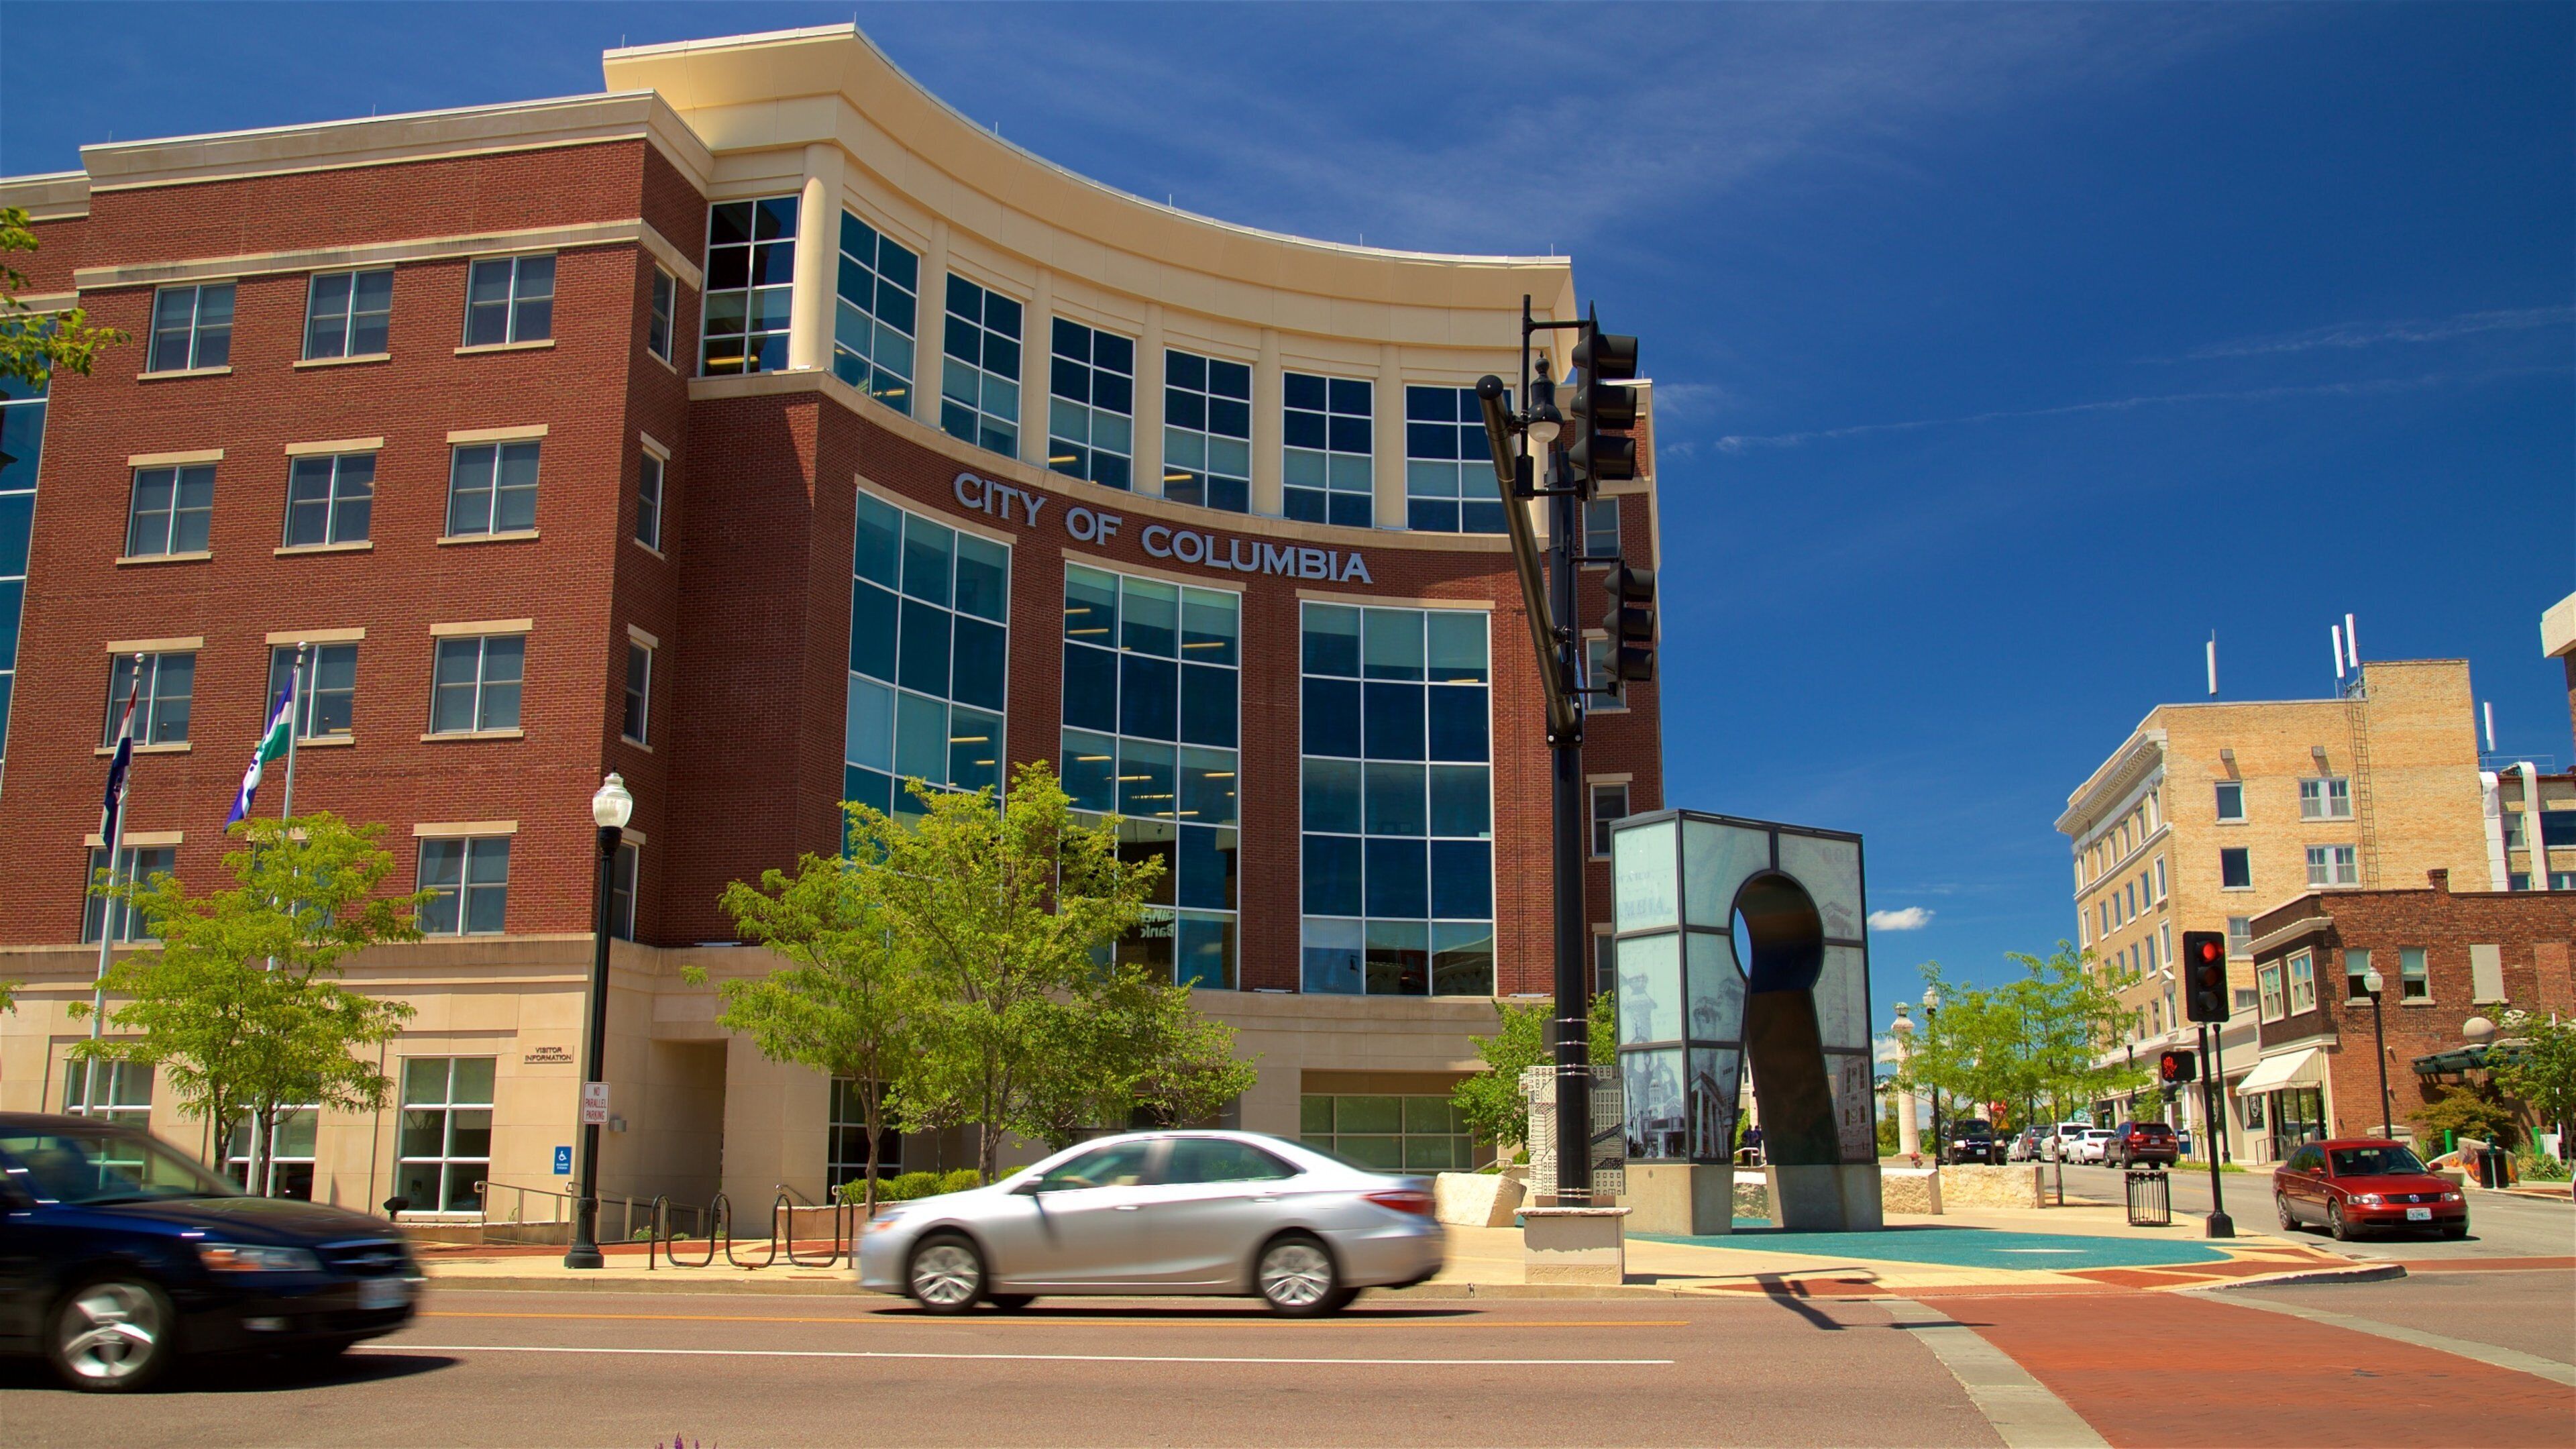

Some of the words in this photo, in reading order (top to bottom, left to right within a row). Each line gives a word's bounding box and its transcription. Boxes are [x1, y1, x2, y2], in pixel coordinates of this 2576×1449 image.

[953, 472, 1046, 527] CITY
[1065, 507, 1122, 545] OF
[1141, 525, 1373, 584] COLUMBIA
[593, 1087, 600, 1096] NO
[585, 1097, 606, 1108] PARALLEL
[586, 1110, 605, 1121] PARKING
